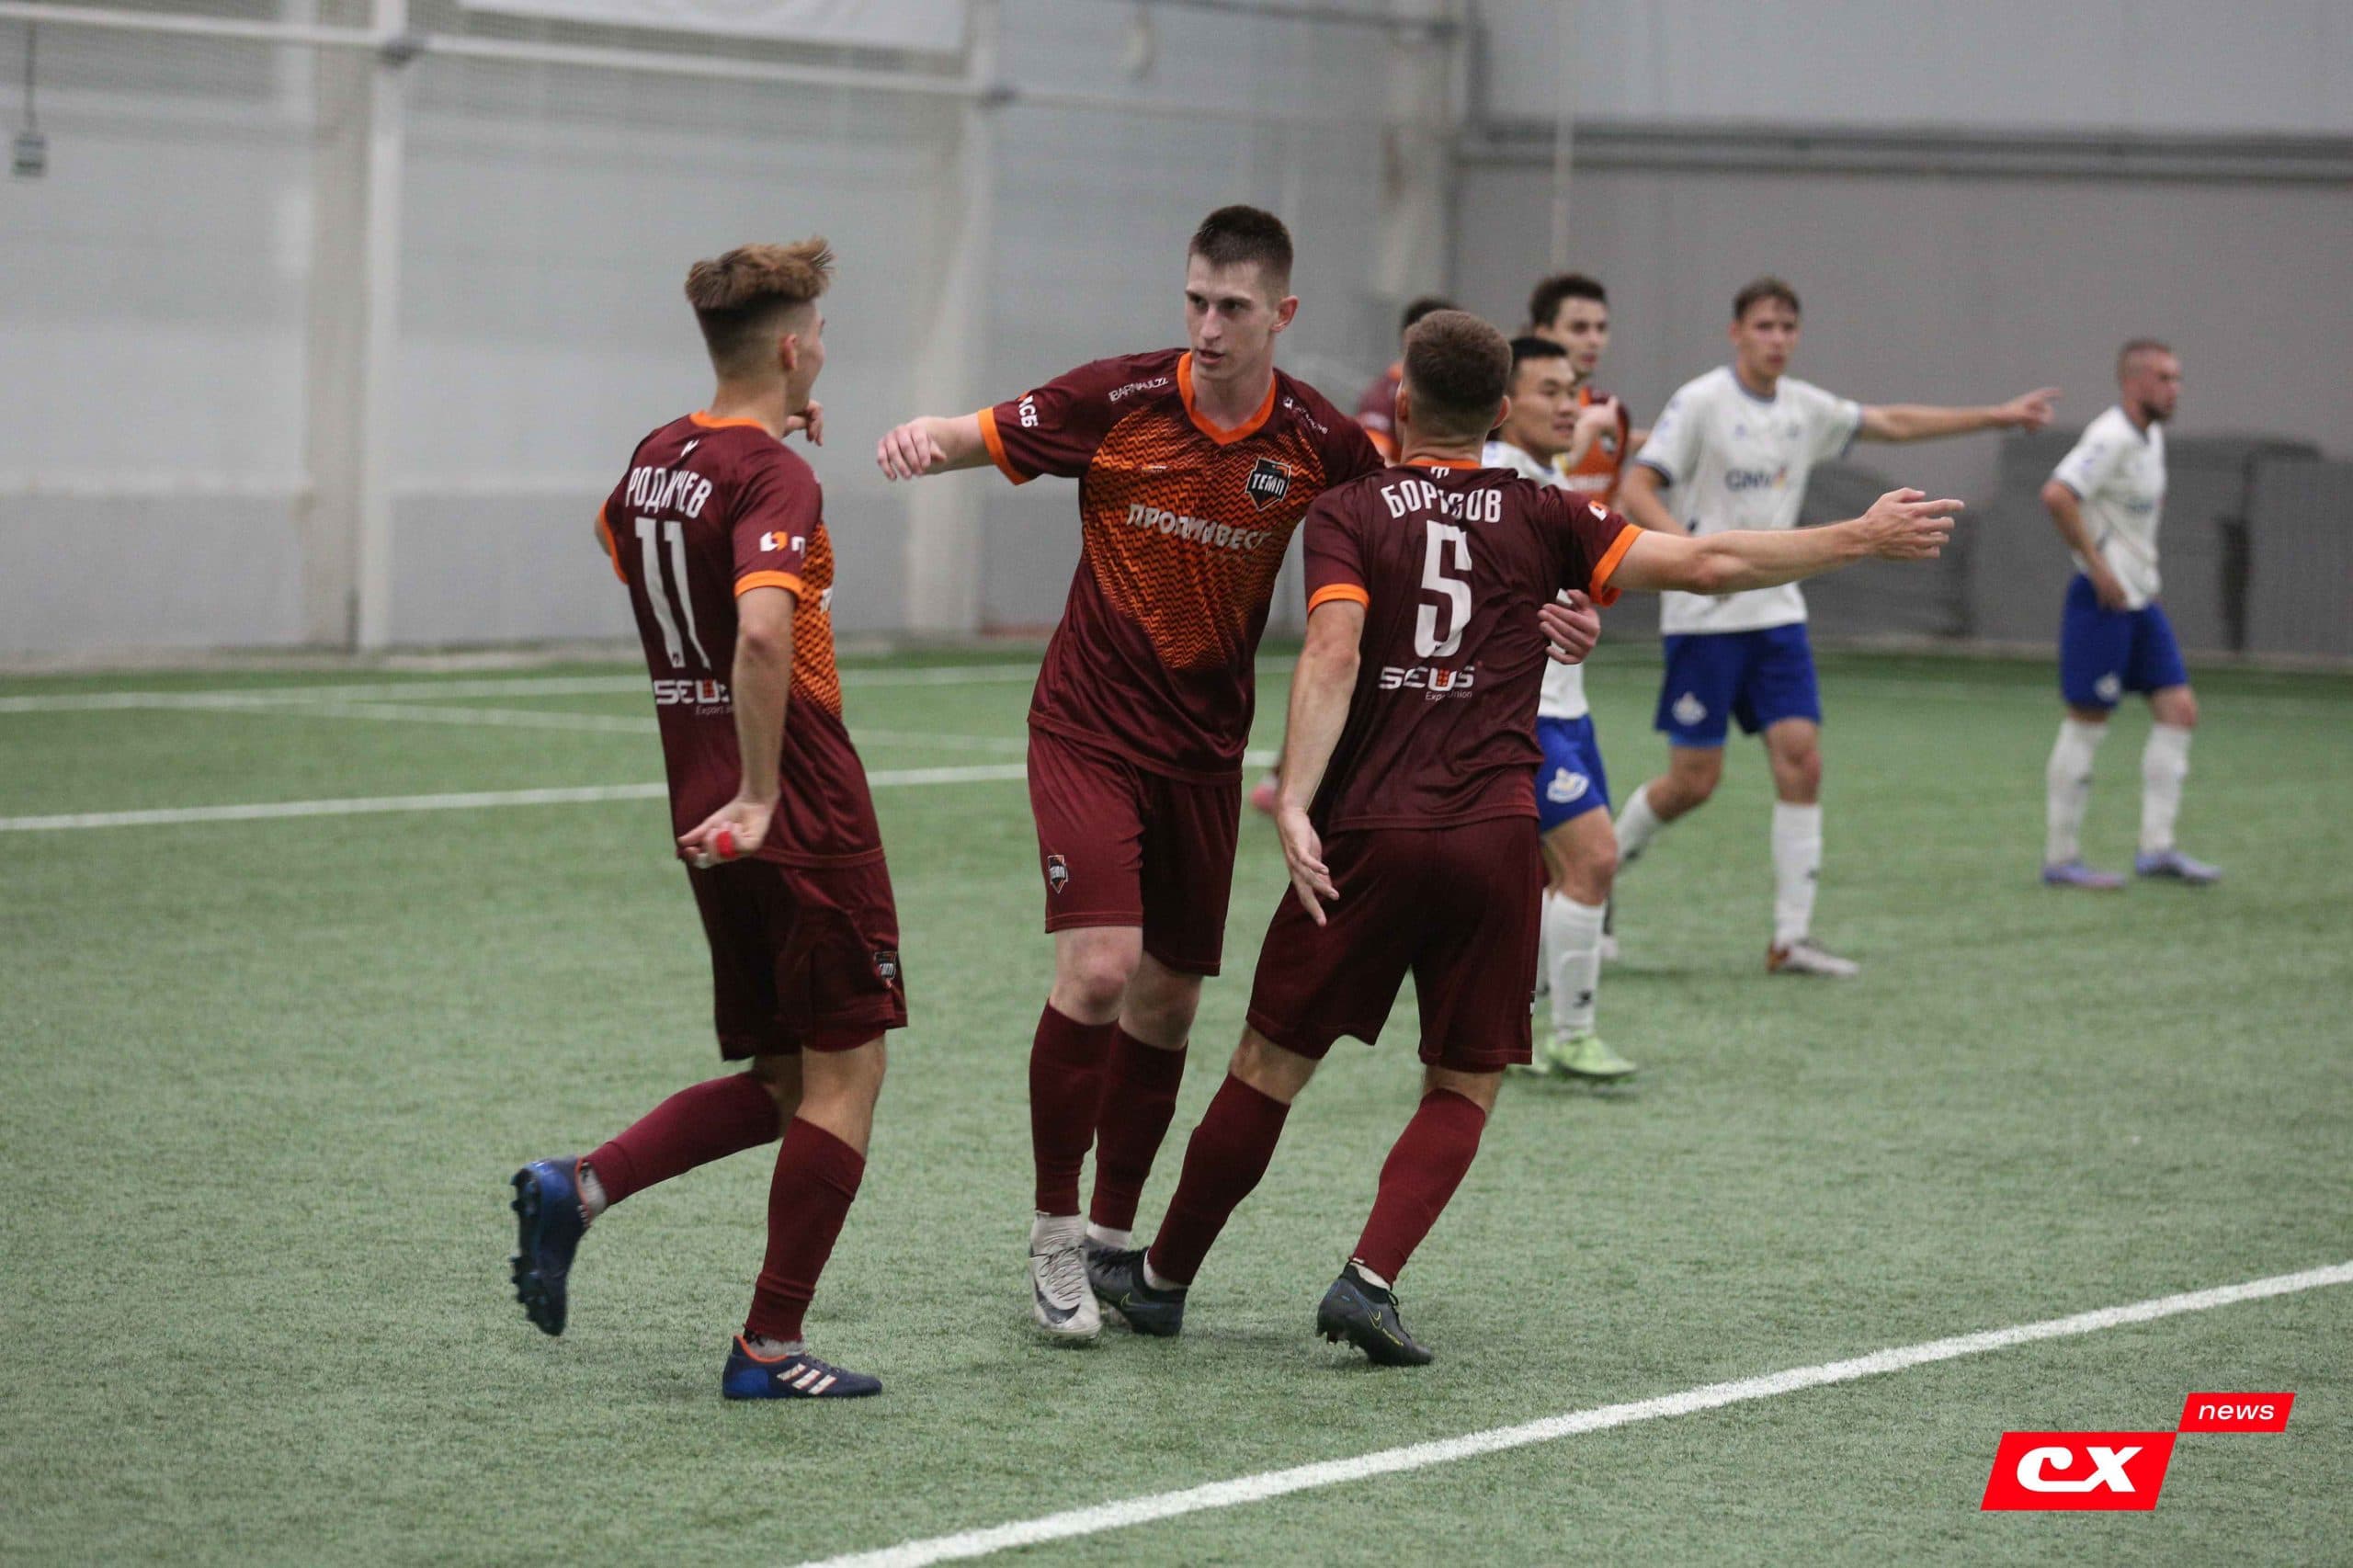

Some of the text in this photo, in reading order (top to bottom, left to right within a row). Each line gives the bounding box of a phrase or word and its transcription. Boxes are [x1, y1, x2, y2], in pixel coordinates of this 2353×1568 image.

[1251, 472, 1287, 496] ТЕМП
[635, 516, 711, 671] 11
[1415, 519, 1472, 658] 5
[1378, 665, 1475, 692] SEUS
